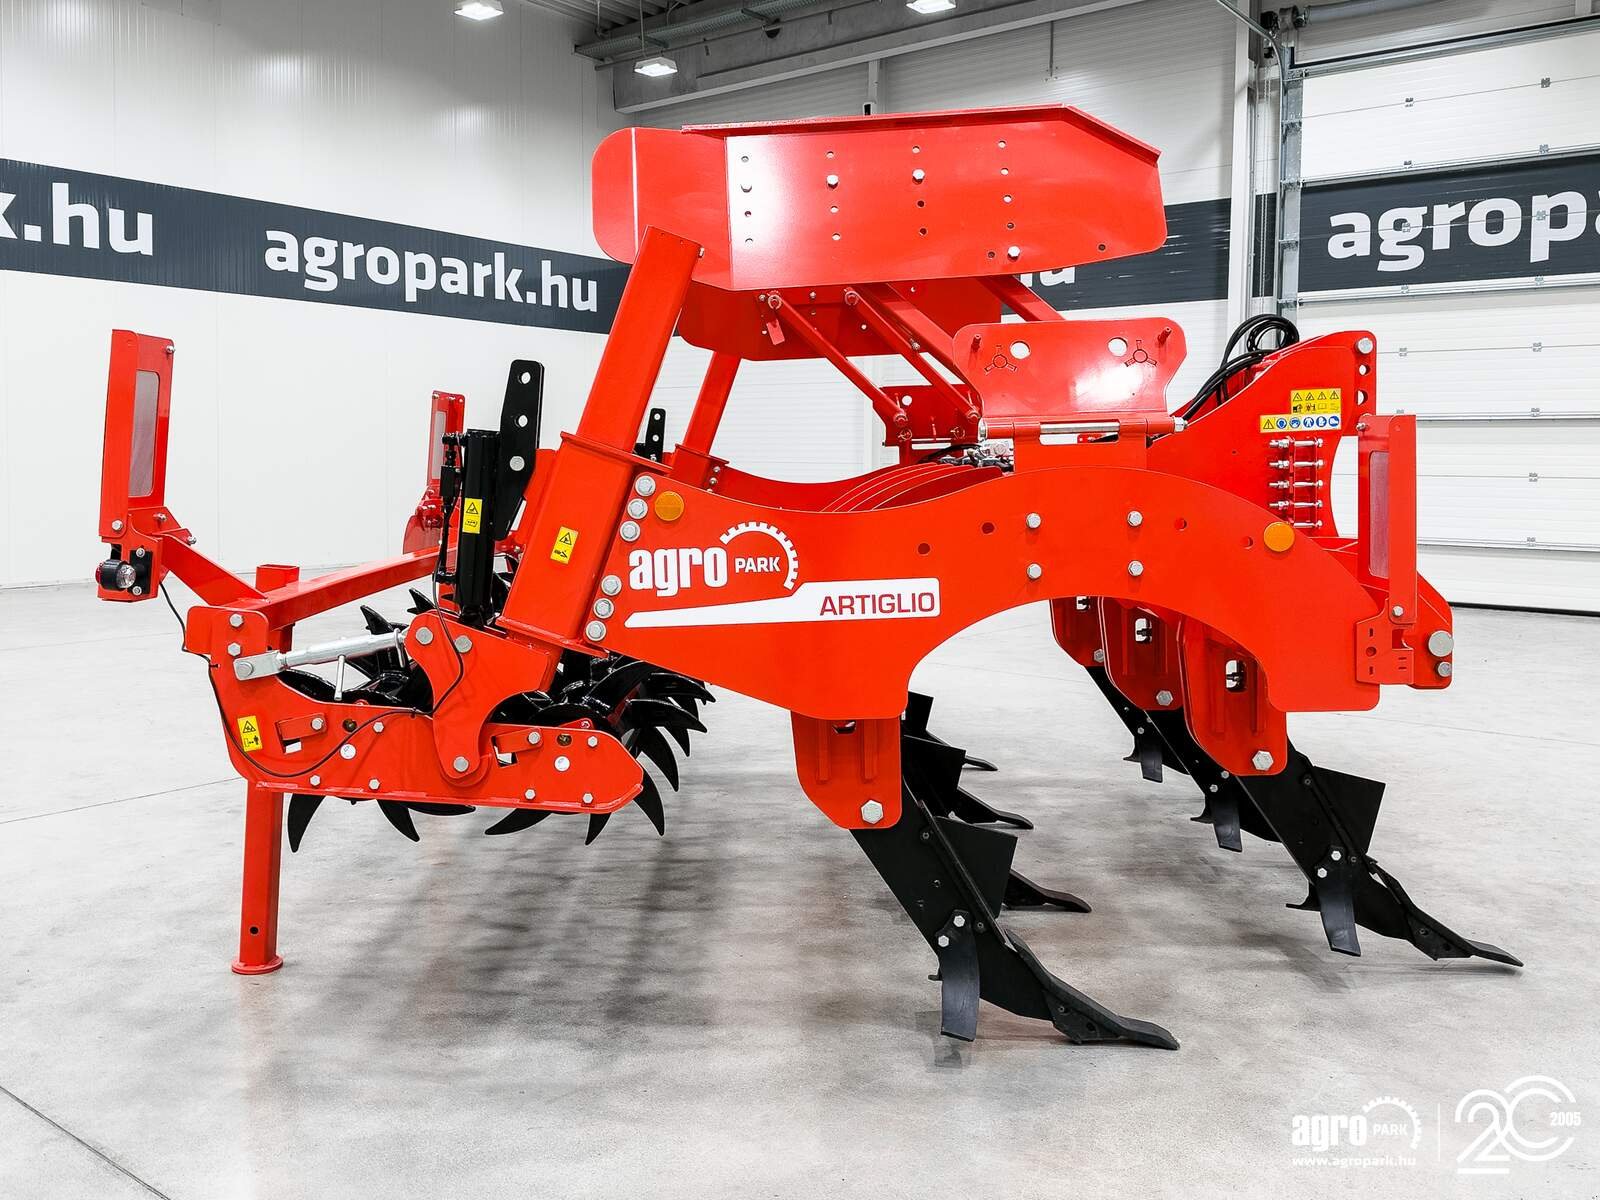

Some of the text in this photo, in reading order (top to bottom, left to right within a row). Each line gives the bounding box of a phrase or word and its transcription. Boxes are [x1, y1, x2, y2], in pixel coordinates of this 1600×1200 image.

[1326, 190, 1600, 272] agrop
[264, 228, 598, 313] agropark.hu
[628, 547, 781, 597] agro PARK
[819, 592, 936, 617] ARTIGLIO
